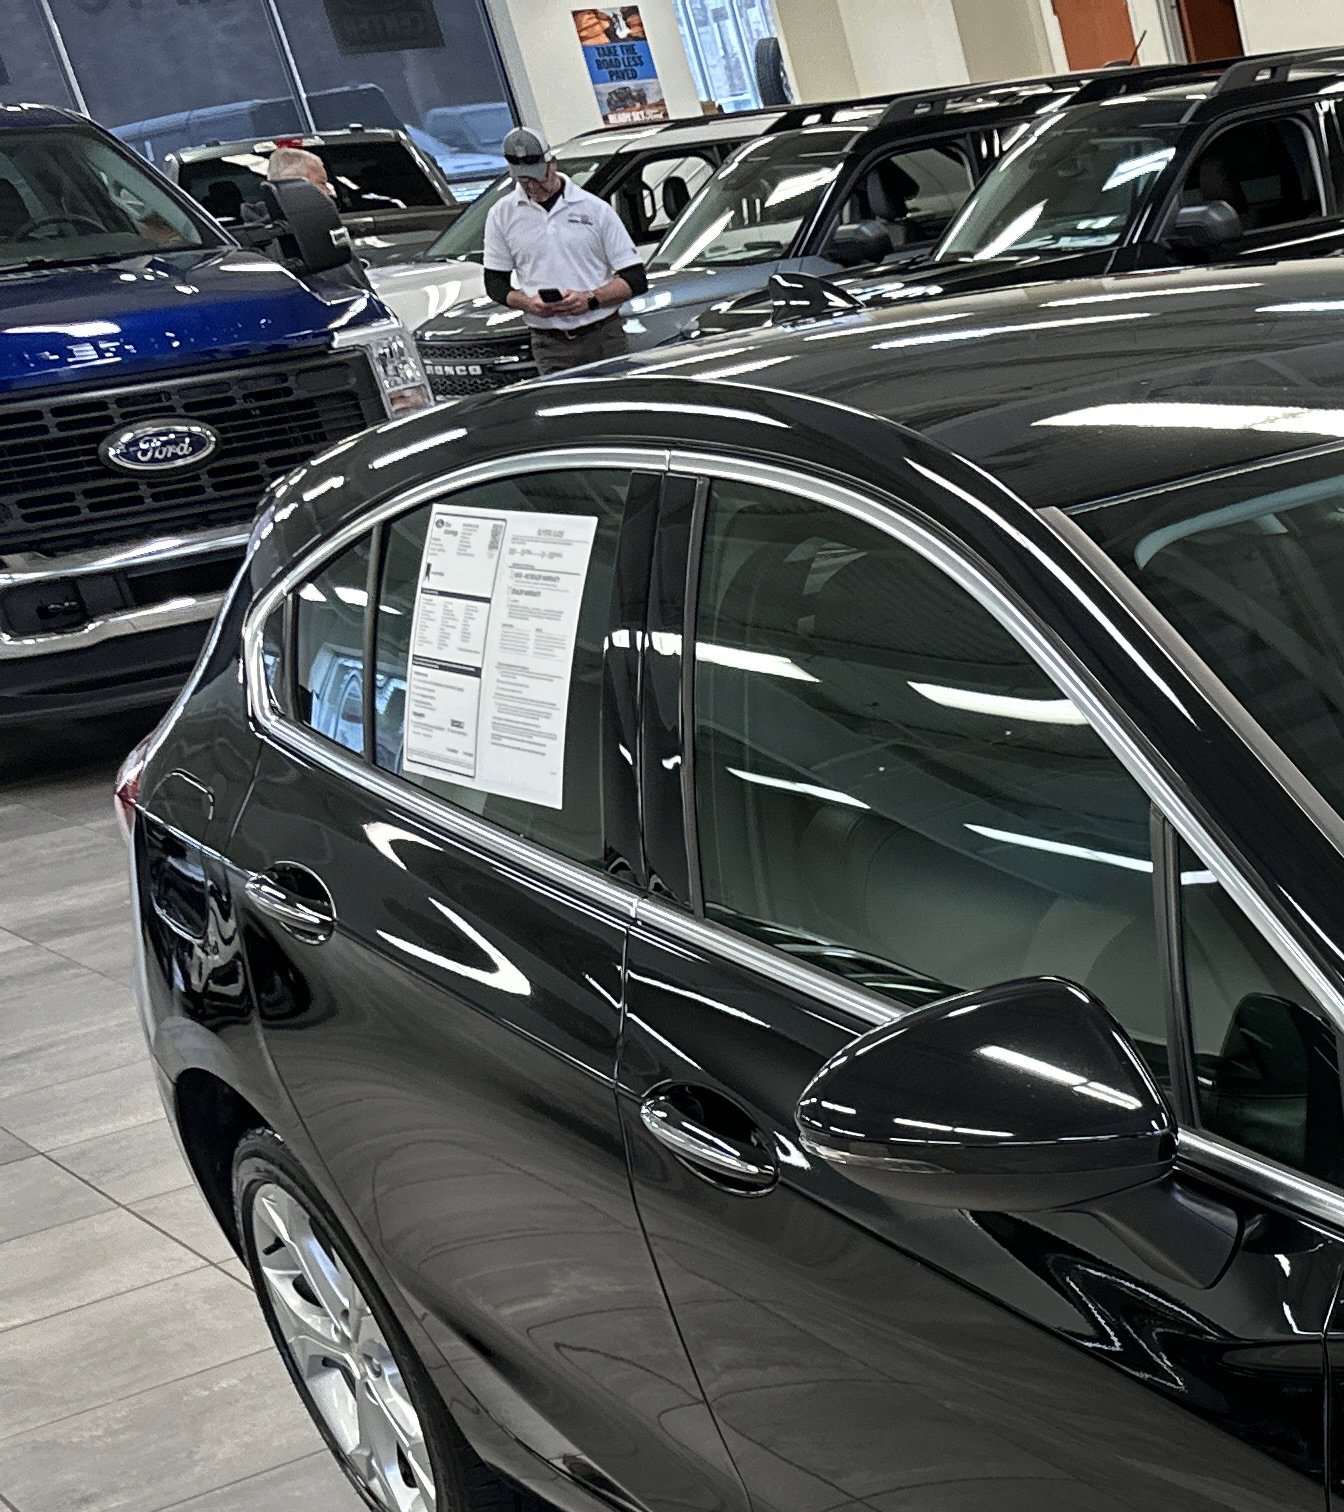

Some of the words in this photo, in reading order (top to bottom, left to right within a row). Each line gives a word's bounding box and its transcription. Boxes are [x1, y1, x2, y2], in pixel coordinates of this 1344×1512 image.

[595, 46, 619, 57] TAKE
[619, 44, 638, 55] THE
[595, 57, 621, 70] ROAD
[622, 55, 644, 67] LESS
[608, 68, 637, 81] PAVED
[137, 436, 192, 461] Ford
